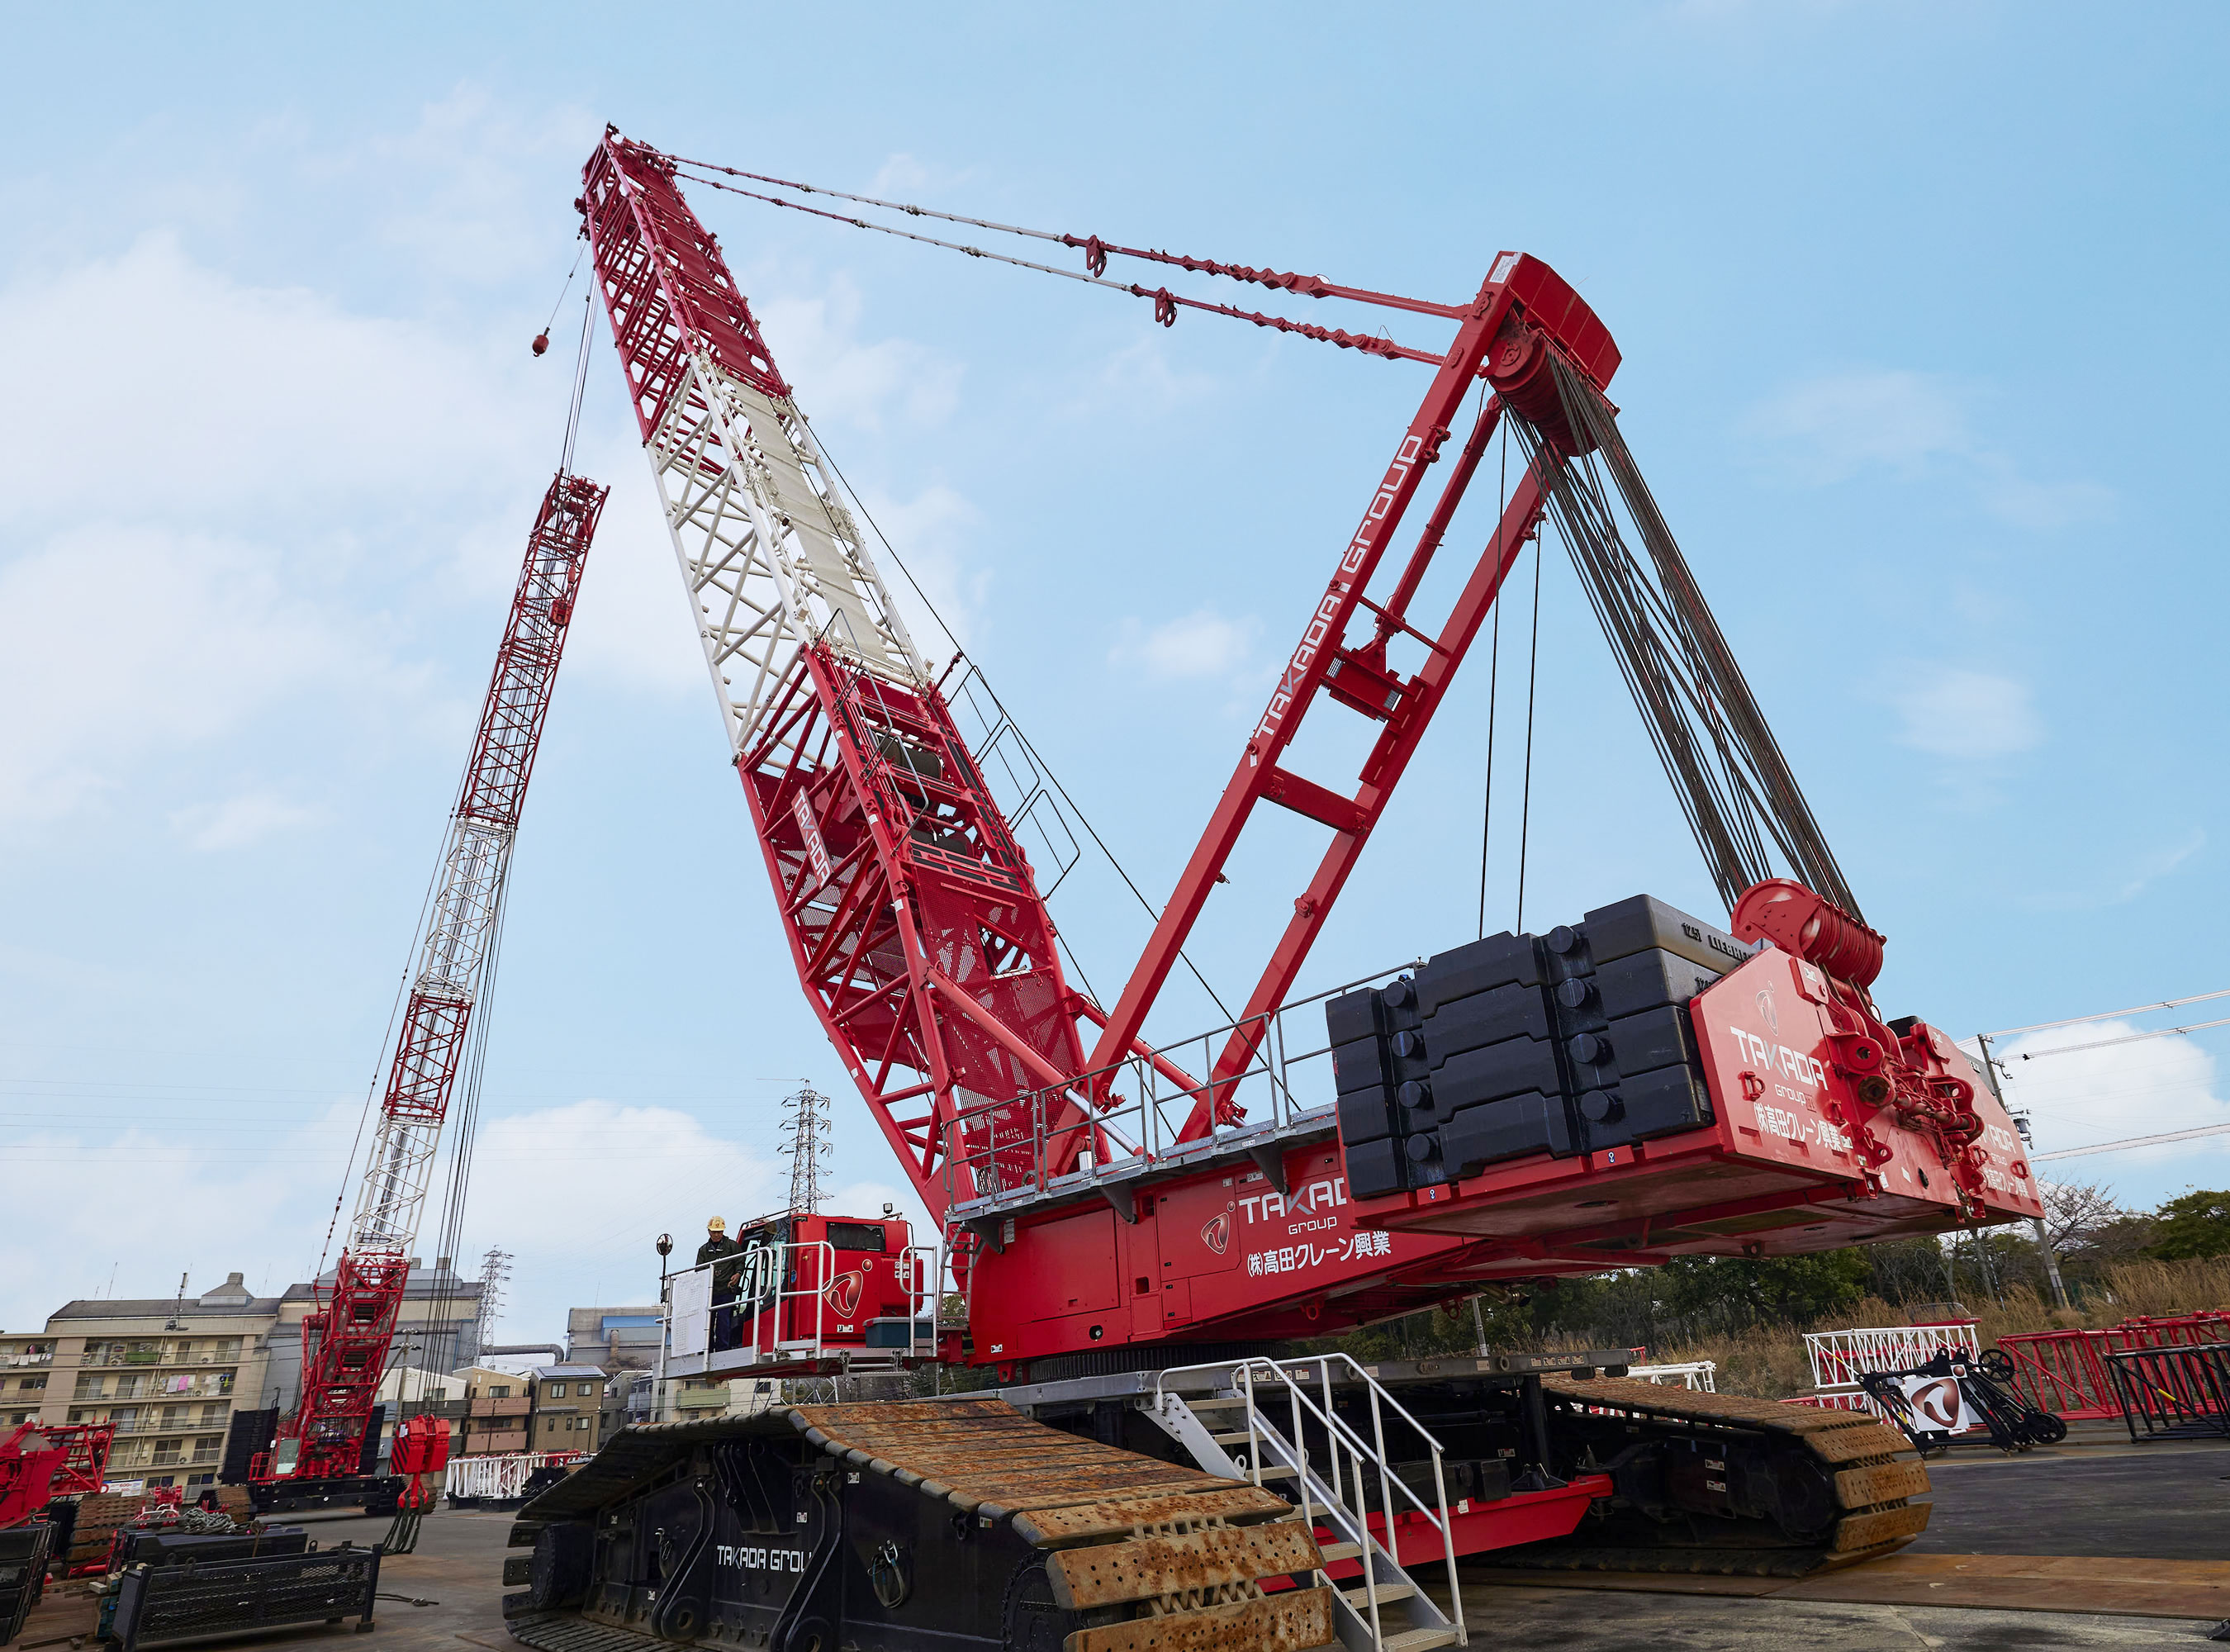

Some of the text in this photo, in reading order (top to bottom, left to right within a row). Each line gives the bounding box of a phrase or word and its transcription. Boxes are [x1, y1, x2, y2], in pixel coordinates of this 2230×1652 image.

[1255, 595, 1342, 738] TAKADA
[794, 788, 831, 887] TAKADA
[1707, 934, 1753, 963] LIEBHE
[1729, 1026, 1829, 1091] TAKADA
[717, 1545, 766, 1569] TAKADA
